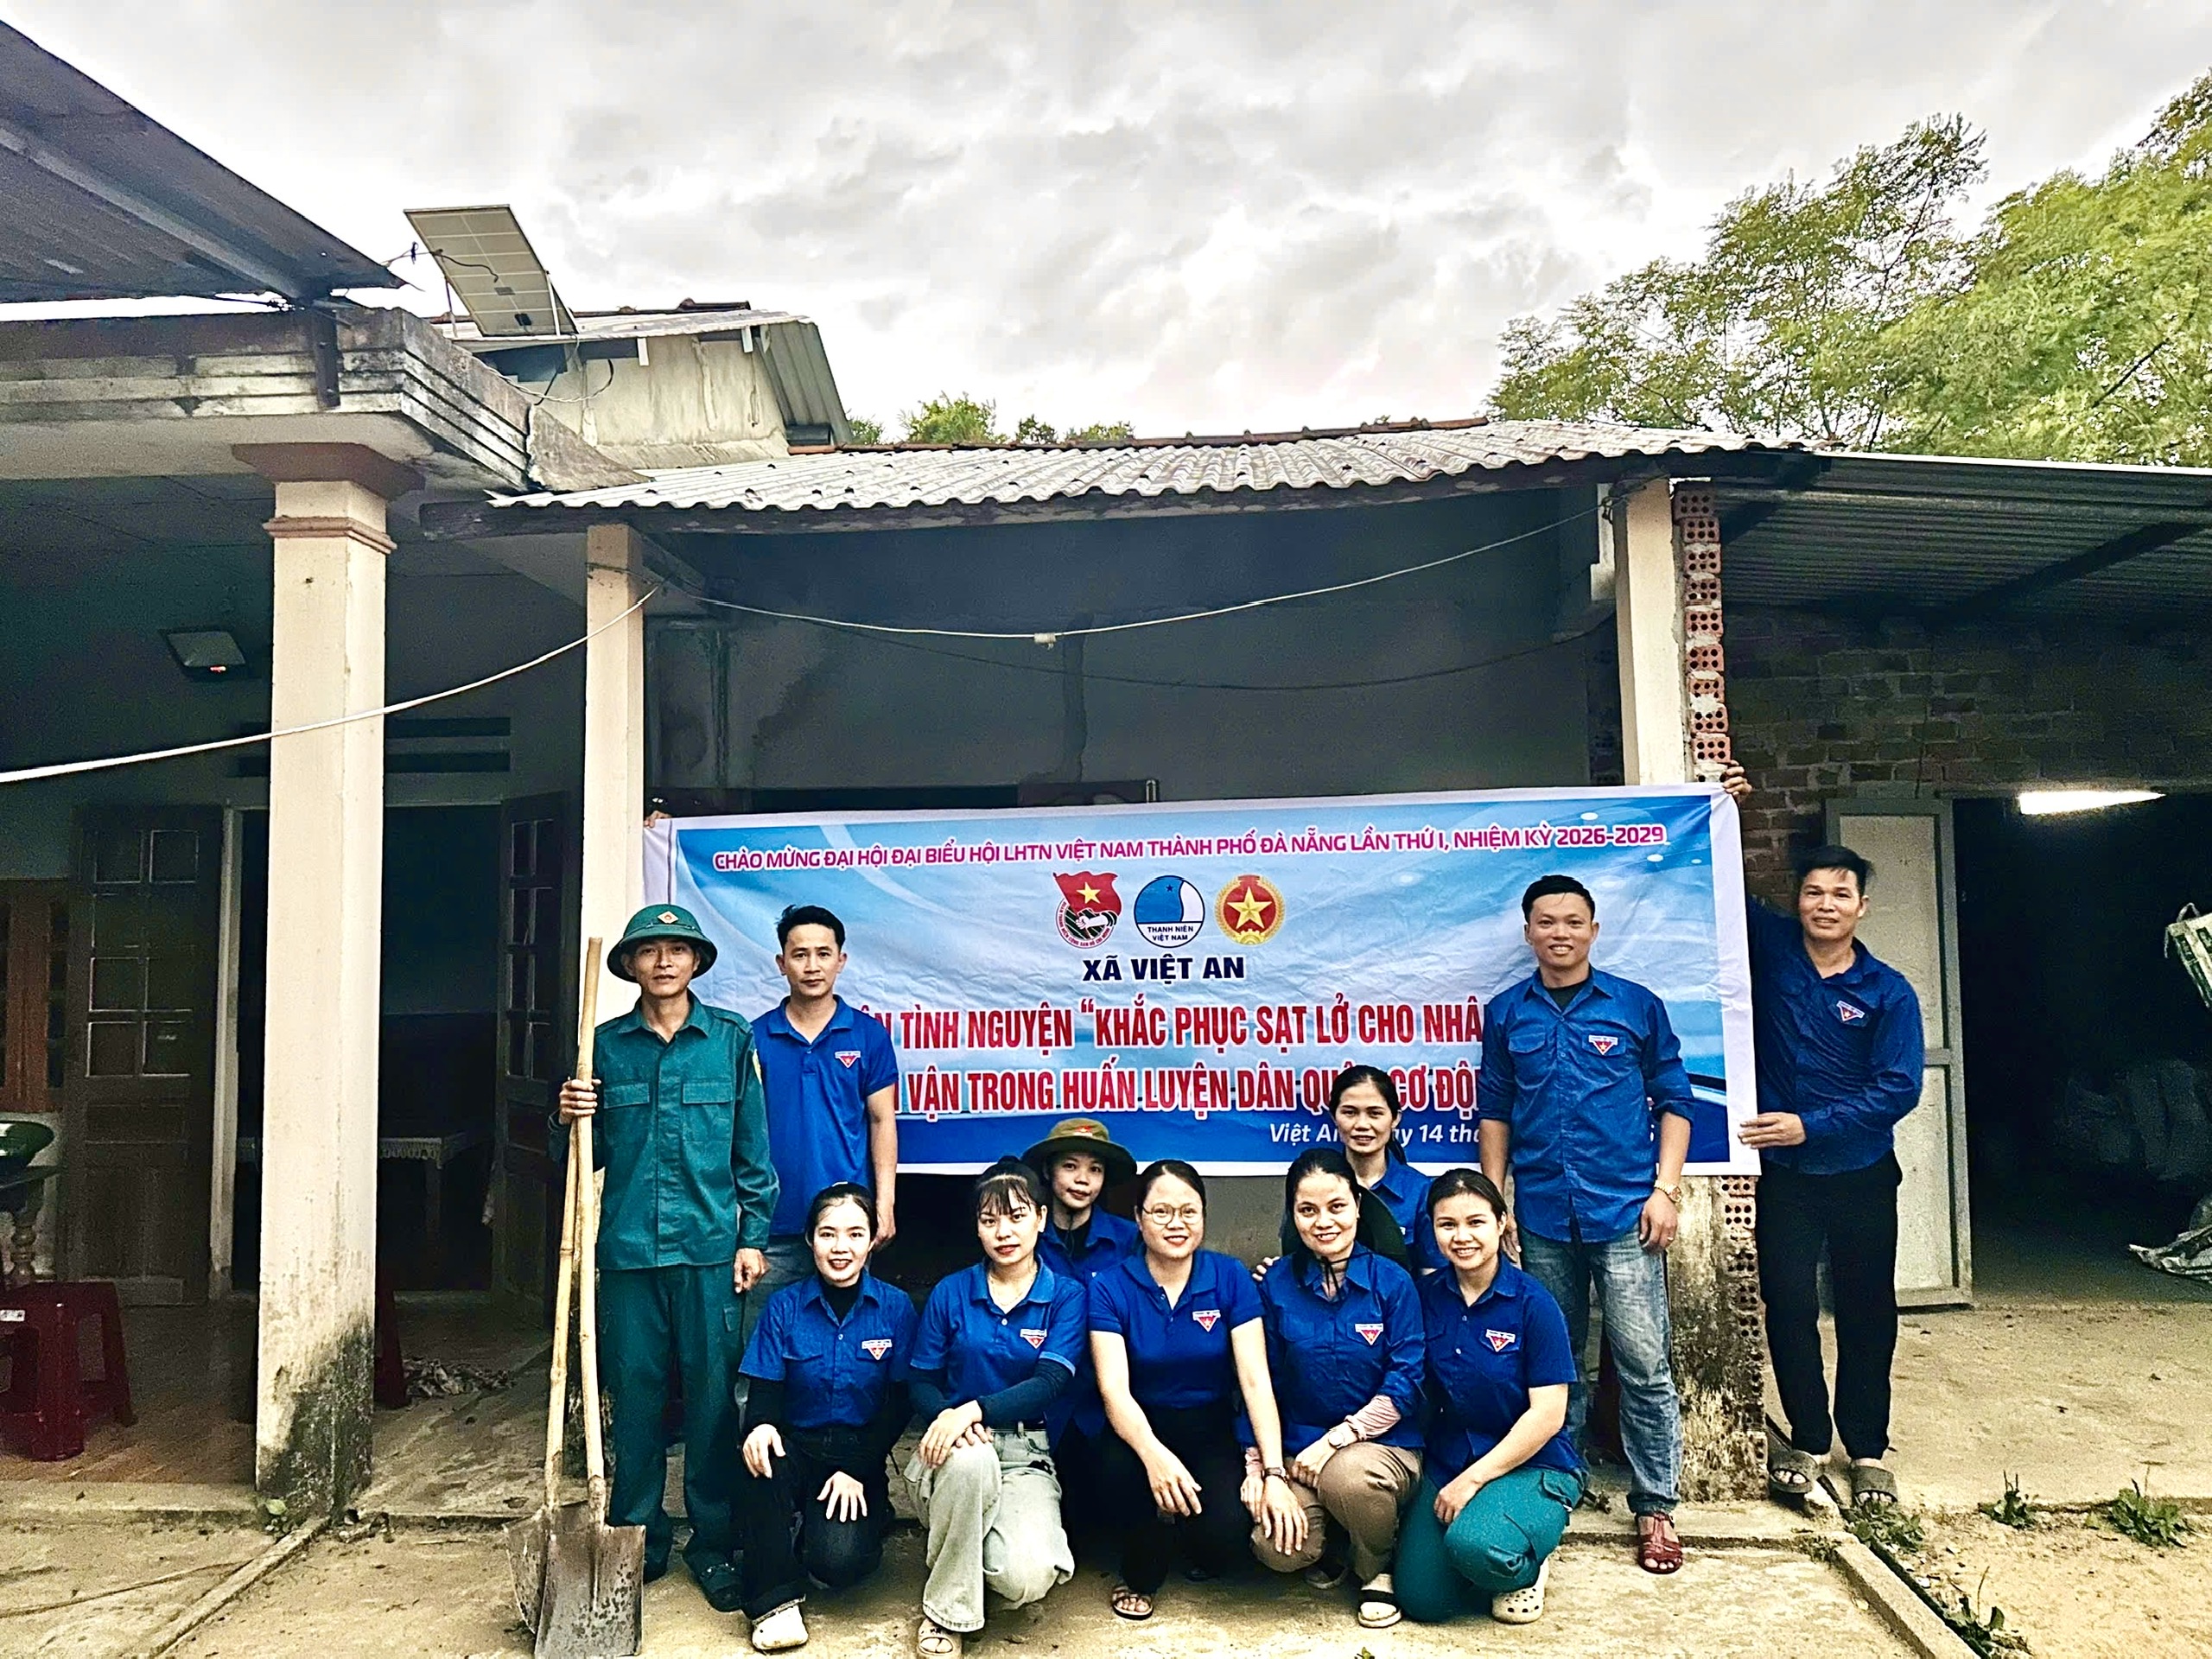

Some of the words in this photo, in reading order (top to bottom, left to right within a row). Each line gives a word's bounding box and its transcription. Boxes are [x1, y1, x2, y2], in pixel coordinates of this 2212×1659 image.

[715, 849, 762, 869] CHÀO
[767, 847, 820, 868] MỪNG
[823, 850, 853, 868] ĐẠI
[858, 845, 887, 868] HỘI
[892, 849, 921, 868] ĐẠI
[925, 839, 965, 863] BIỂU
[969, 842, 1000, 864] HỘI
[1004, 844, 1052, 861] LHTN
[1057, 838, 1096, 862] VIỆT
[1101, 842, 1143, 858] NAM
[1147, 835, 1212, 856] THÀNH
[1217, 830, 1257, 855] PHỐ
[1260, 832, 1287, 853] ĐÀ
[1292, 828, 1346, 852] NẴNG
[1351, 826, 1389, 851] LẦN
[1394, 828, 1434, 850] THỨ
[1439, 832, 1449, 851] I,
[1454, 826, 1520, 850] NHIỆM
[1525, 824, 1553, 847] KỲ
[1557, 826, 1664, 846] 2026-2029
[1152, 933, 1169, 942] VIỆT
[1083, 955, 1122, 981] XÃ
[1131, 953, 1193, 984] VIỆT
[1202, 957, 1244, 980] AN
[900, 1004, 959, 1049] TÌNH
[968, 1001, 1072, 1055] NGUYỆN
[1081, 994, 1166, 1046] “KHẮC
[1175, 1007, 1247, 1053] PHỤC
[1256, 1006, 1307, 1053] SẠT
[1316, 993, 1350, 1044] LỞ
[1358, 1004, 1414, 1044] CHO
[1423, 995, 1485, 1043] NHÂ
[907, 1065, 959, 1119] VẬN
[967, 1071, 1053, 1110] TRONG
[1063, 1057, 1135, 1109] HUẤN
[1144, 1062, 1229, 1116] LUYỆN
[1237, 1062, 1294, 1109] DÂN
[1269, 1122, 1312, 1146] Việt
[1419, 1124, 1444, 1143] 14
